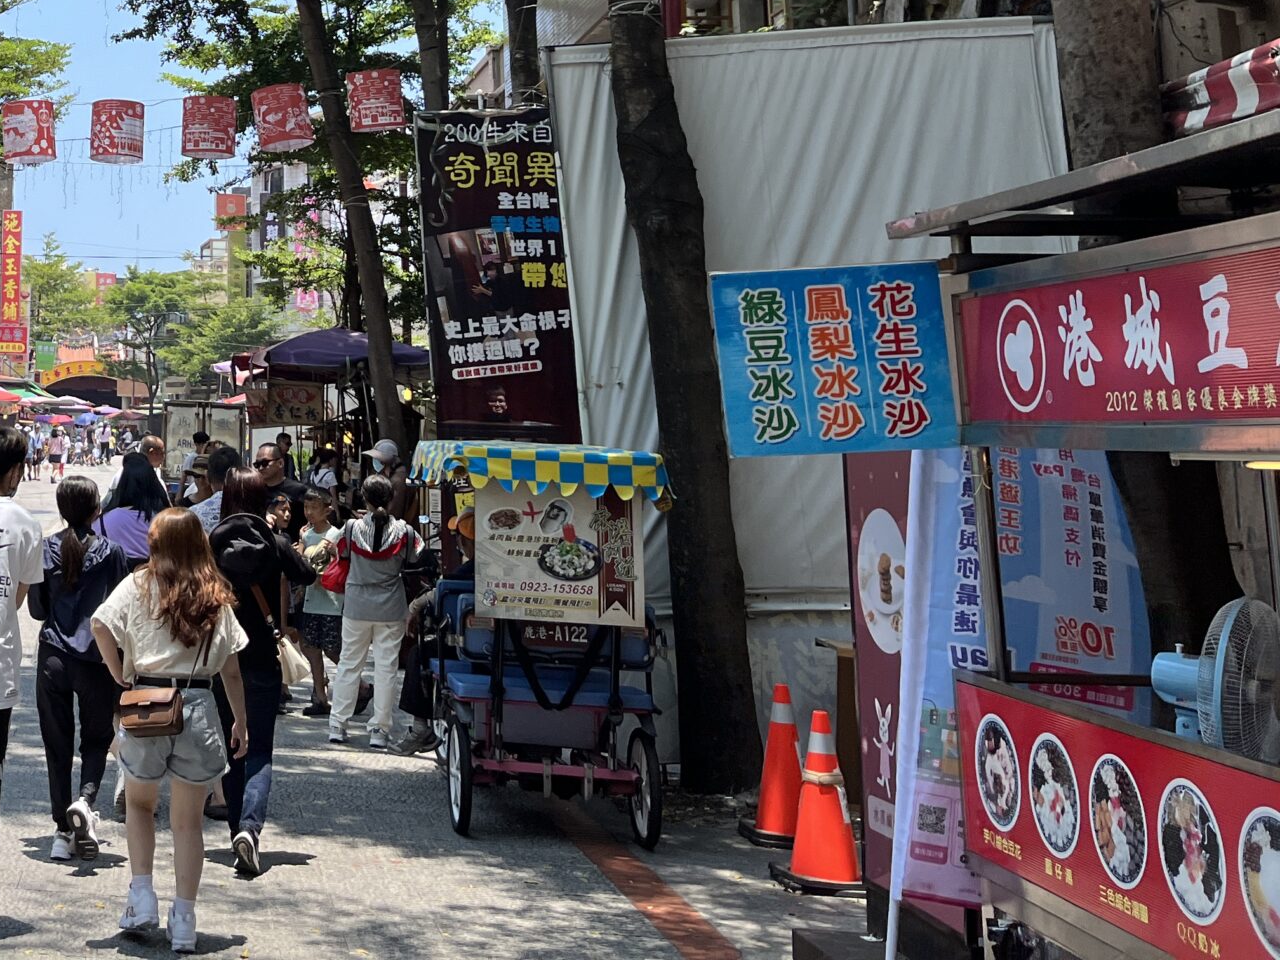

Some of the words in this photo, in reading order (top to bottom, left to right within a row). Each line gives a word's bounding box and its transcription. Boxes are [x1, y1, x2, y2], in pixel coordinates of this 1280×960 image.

[444, 151, 556, 189] 奇聞異
[444, 308, 571, 340] 史上最大命根子
[867, 280, 930, 438] 花生冰沙
[1057, 273, 1280, 387] 港城豆
[738, 286, 800, 444] 綠豆冰沙
[804, 283, 866, 442] 鳳梨冰沙
[1105, 391, 1138, 412] 2012
[520, 581, 594, 595] 0923-153658
